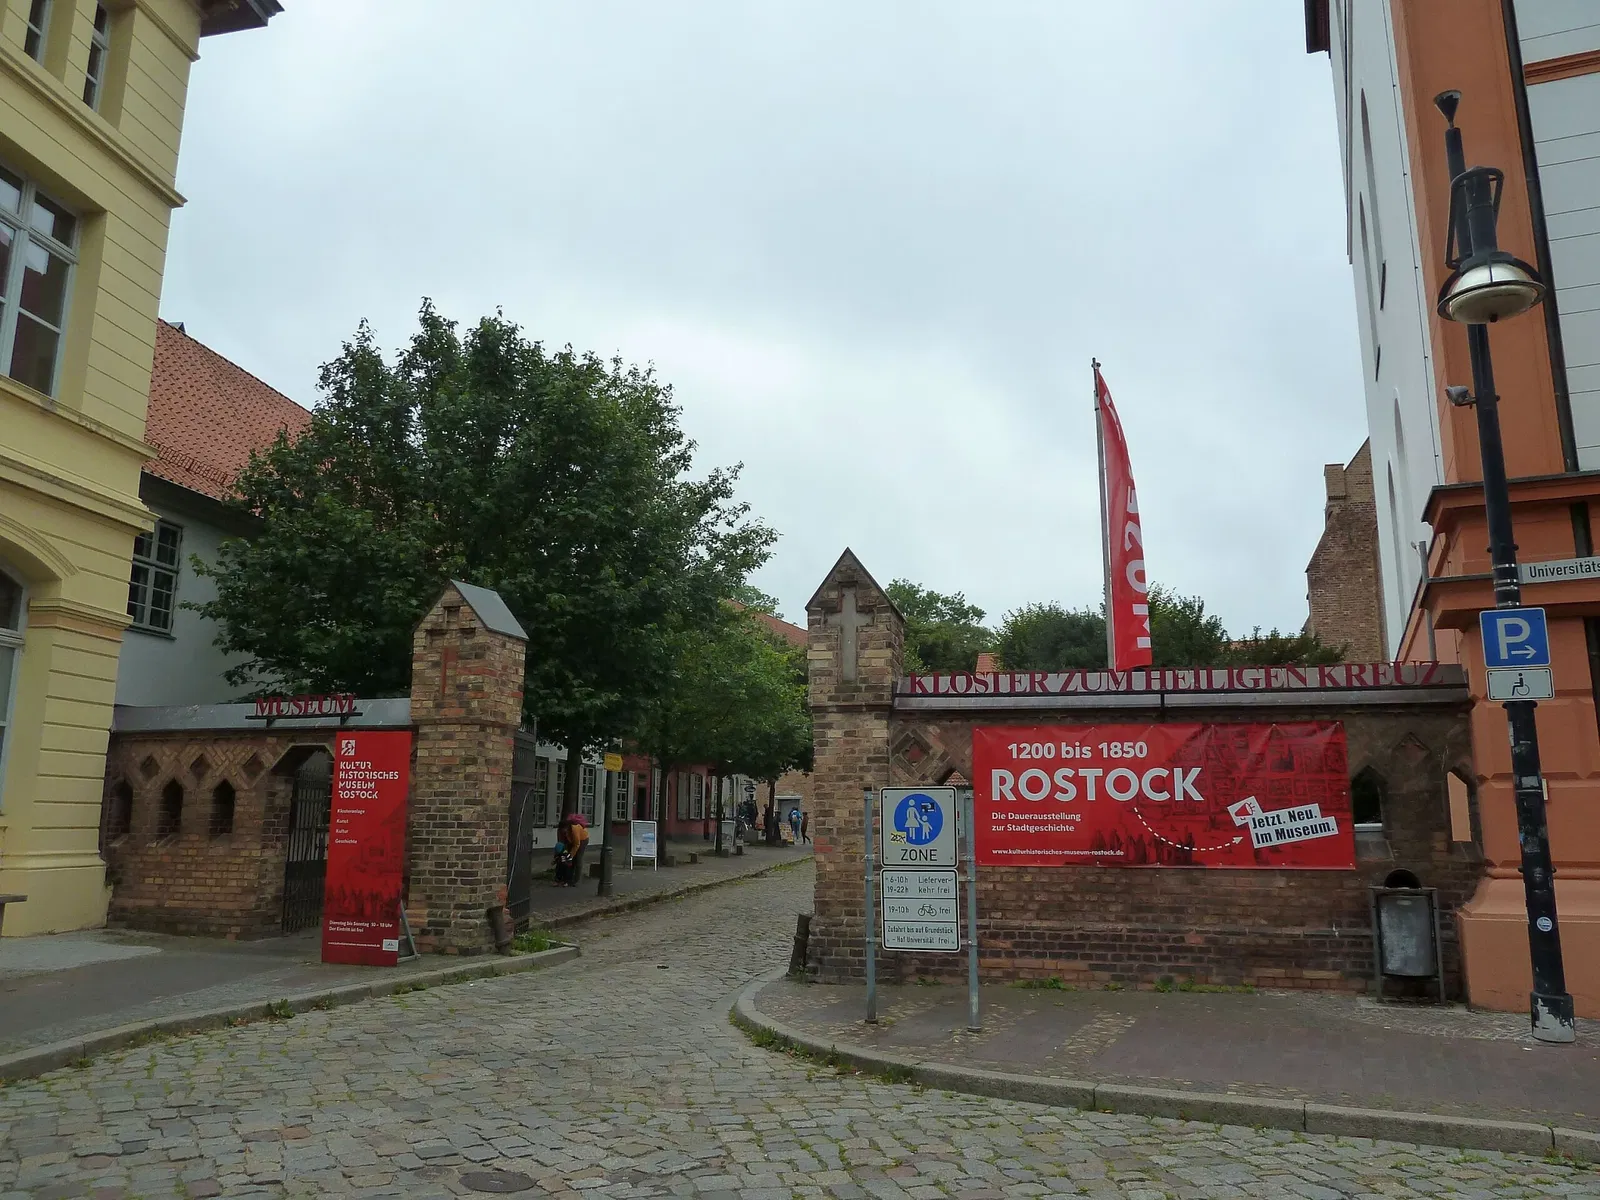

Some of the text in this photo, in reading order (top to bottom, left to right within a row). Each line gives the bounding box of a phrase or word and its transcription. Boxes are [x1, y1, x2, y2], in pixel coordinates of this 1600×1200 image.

[1496, 617, 1531, 660] P
[909, 660, 1444, 695] KLOSTER ZUM HEILIGEN KREUZ
[255, 694, 357, 716] MUSEUM
[1007, 741, 1148, 759] 1200 bis 1850
[340, 761, 372, 769] KULTUR
[338, 780, 375, 789] MUSEUM
[991, 767, 1205, 802] ROSTOCK
[338, 790, 379, 799] ROSTOCK
[991, 812, 1081, 822] Die Dauerausstellung
[1252, 809, 1318, 829] Jetzt. Neu.
[1007, 823, 1075, 833] Stadtgeschichte
[1255, 822, 1335, 845] Im Museum.
[900, 849, 938, 861] ZONE
[918, 886, 934, 894] kehr
[937, 886, 950, 894] frei
[939, 906, 951, 914] frei
[924, 926, 954, 934] Grundstück
